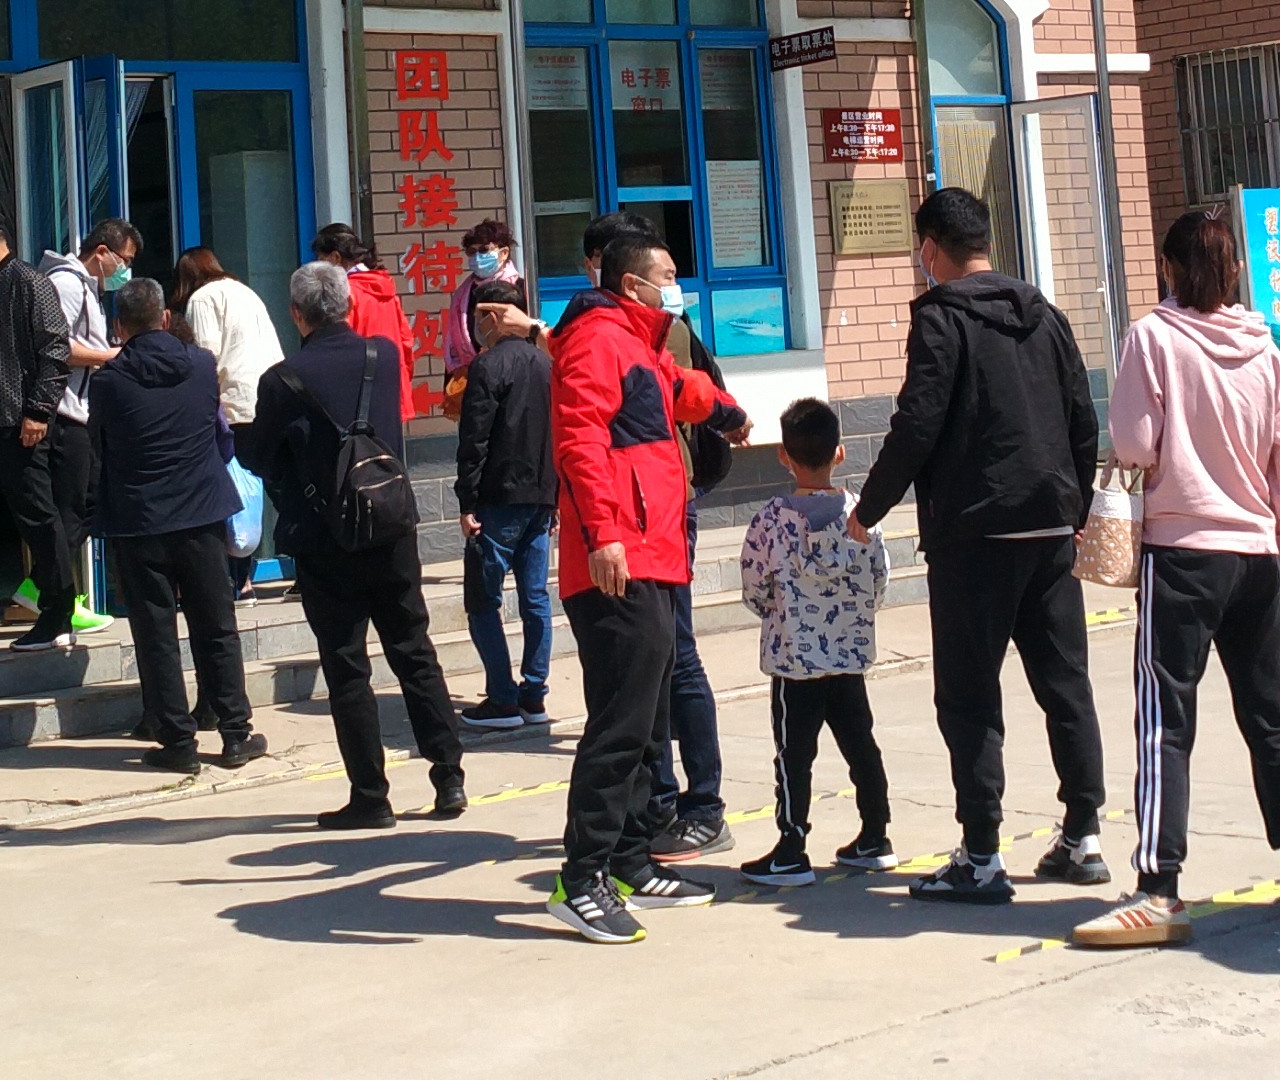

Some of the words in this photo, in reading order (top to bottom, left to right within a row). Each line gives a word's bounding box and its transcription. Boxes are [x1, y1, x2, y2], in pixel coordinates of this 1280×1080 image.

[771, 30, 834, 57] 电子票取票处
[621, 67, 672, 89] 电子票
[631, 96, 664, 114] 窗口
